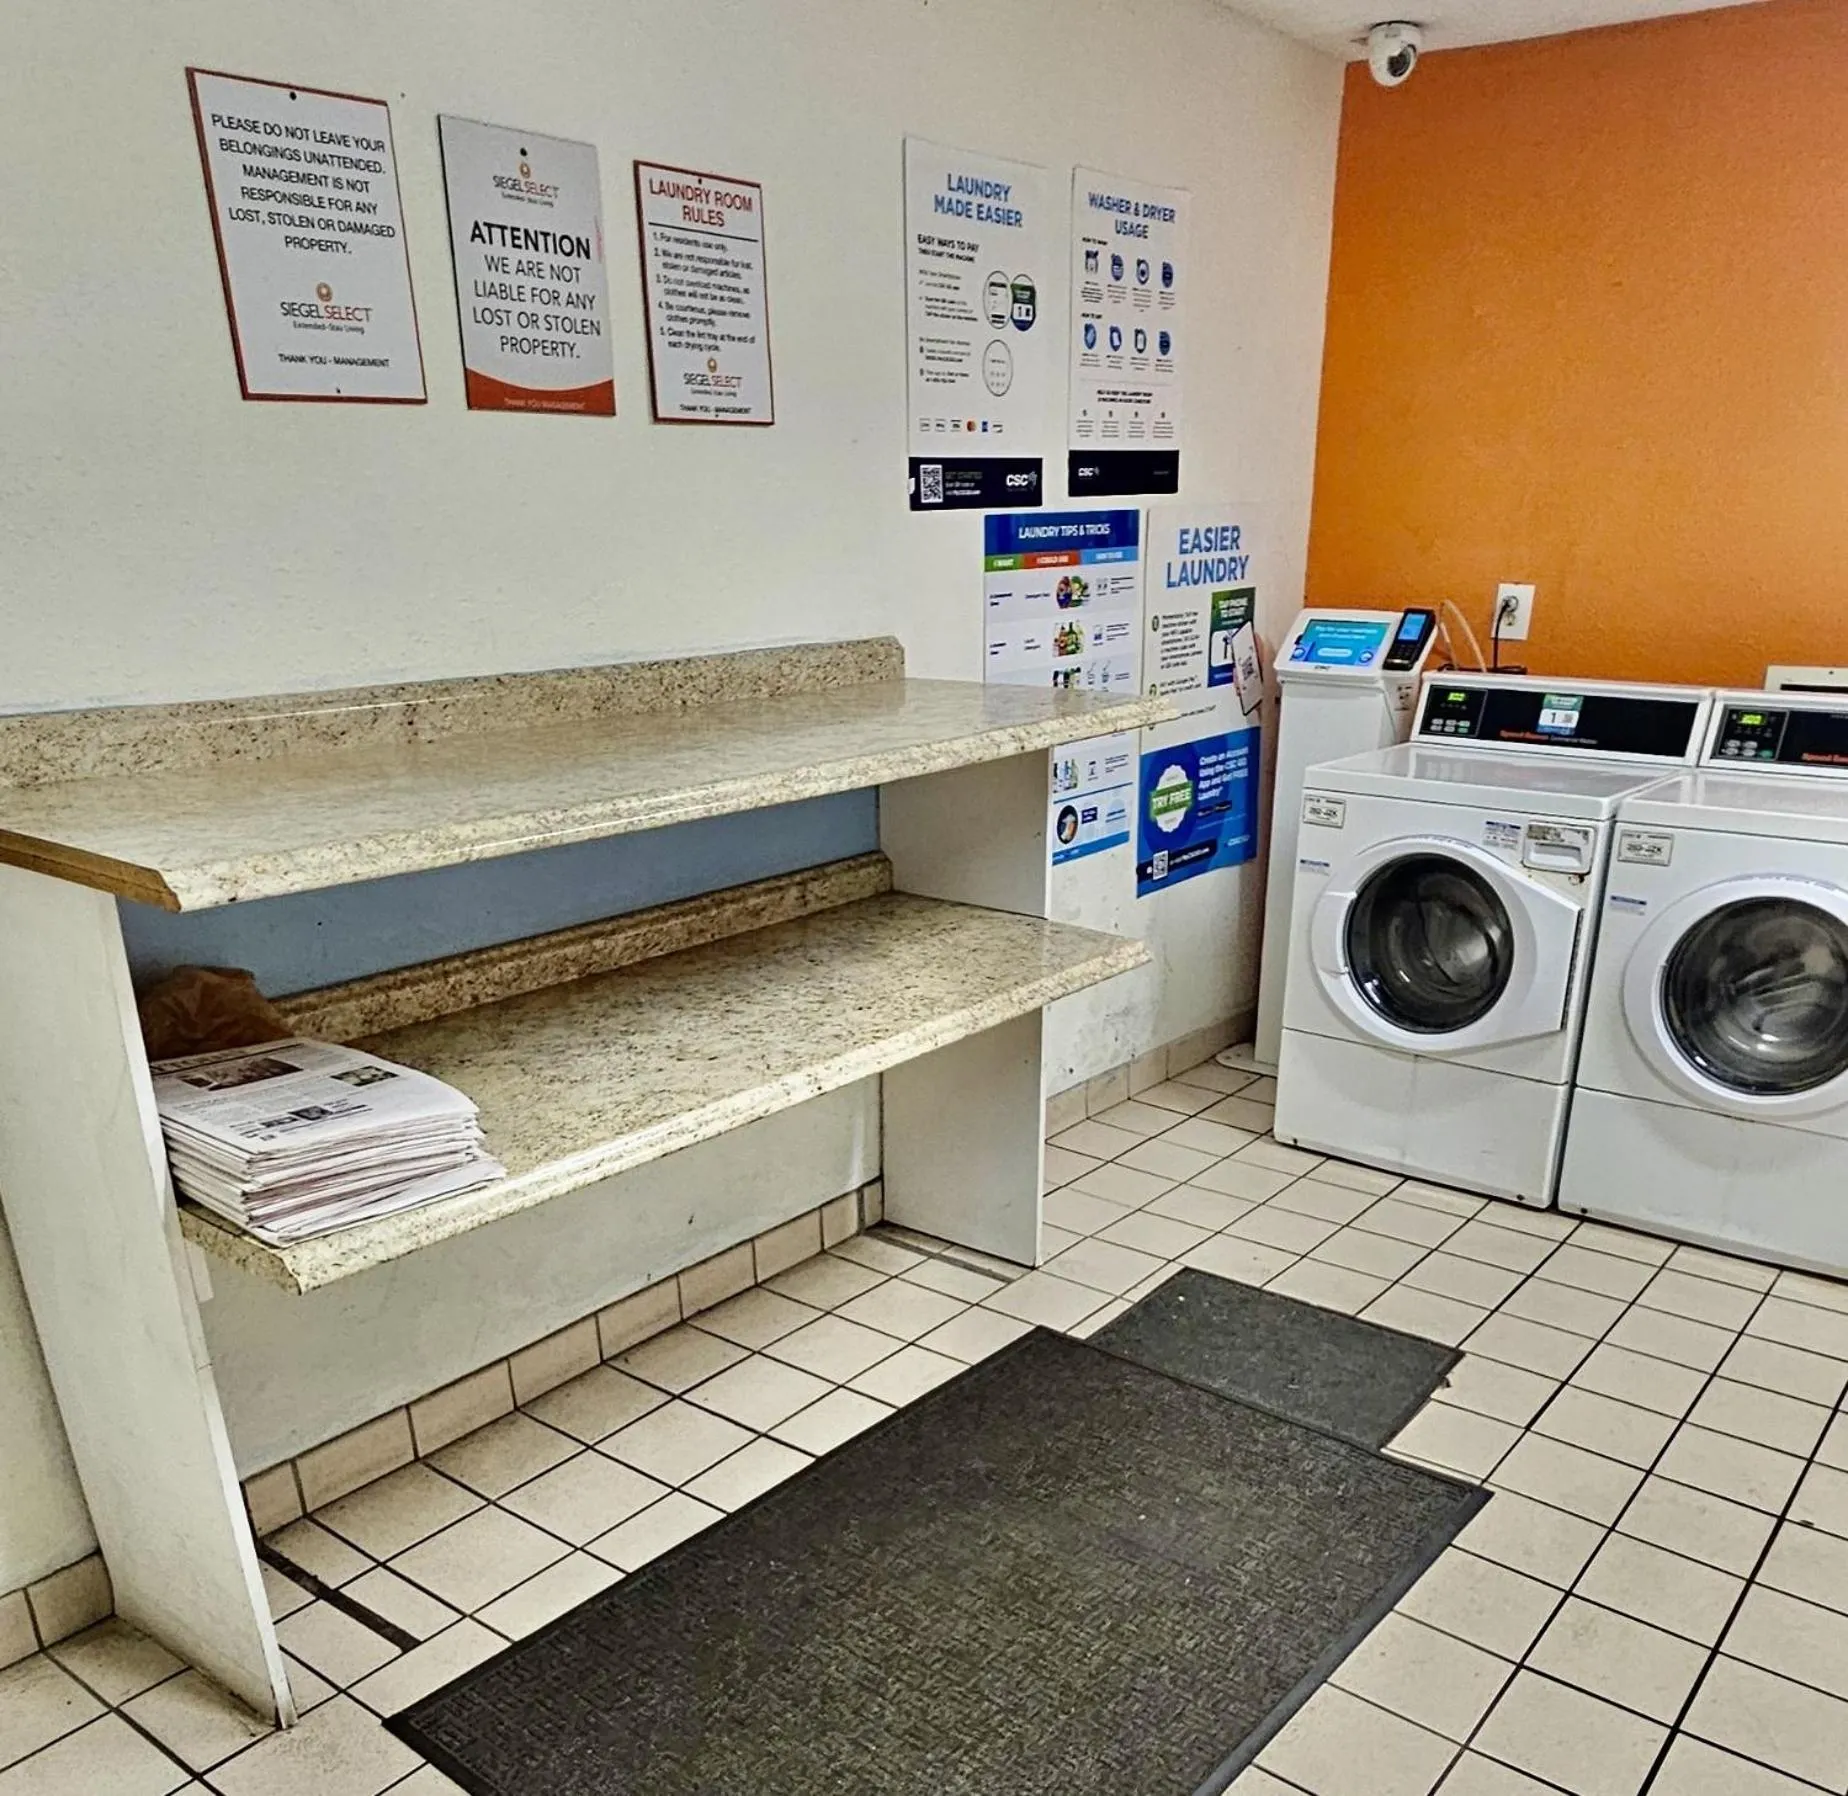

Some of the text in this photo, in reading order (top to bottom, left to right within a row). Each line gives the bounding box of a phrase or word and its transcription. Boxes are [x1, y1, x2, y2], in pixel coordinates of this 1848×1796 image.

[211, 113, 385, 153] PLEASE DO NOT LEAVE YOUR
[219, 138, 386, 175] BELONGINGS UNATTENDED.
[242, 164, 370, 194] MANAGEMENT IS NOT
[947, 173, 1012, 203] LAUNDRY
[240, 186, 378, 215] RESPONSIBLE FOR ANY
[649, 178, 752, 213] LAUNDRY ROOM
[1088, 192, 1176, 223] WASHER & DRYER
[228, 207, 395, 238] LOST, STOLEN OR DAMAGED
[682, 204, 725, 228] RULES
[934, 194, 1024, 228] MADE EASIER
[470, 220, 591, 260] ATTENTION
[917, 234, 979, 253] EASY WAYS TO PAY
[1114, 219, 1149, 239] USAGE
[284, 236, 353, 255] PROPERTY.
[696, 255, 730, 266] responsible
[484, 254, 582, 284] WE ARE NOT
[474, 280, 596, 310] LIABLE FOR ANY
[473, 306, 601, 336] LOST OR STOLEN
[278, 354, 390, 368] THANK YOU MANAGEMENT
[500, 335, 581, 359] PROPERTY.
[1006, 474, 1028, 486] CSC
[1019, 523, 1111, 539] LAUNDRY TIPS & TRICKS
[1179, 525, 1241, 555] EASIER
[1166, 555, 1249, 588] LAUNDRY
[1551, 712, 1556, 724] 1
[1152, 788, 1192, 809] TRY FREE
